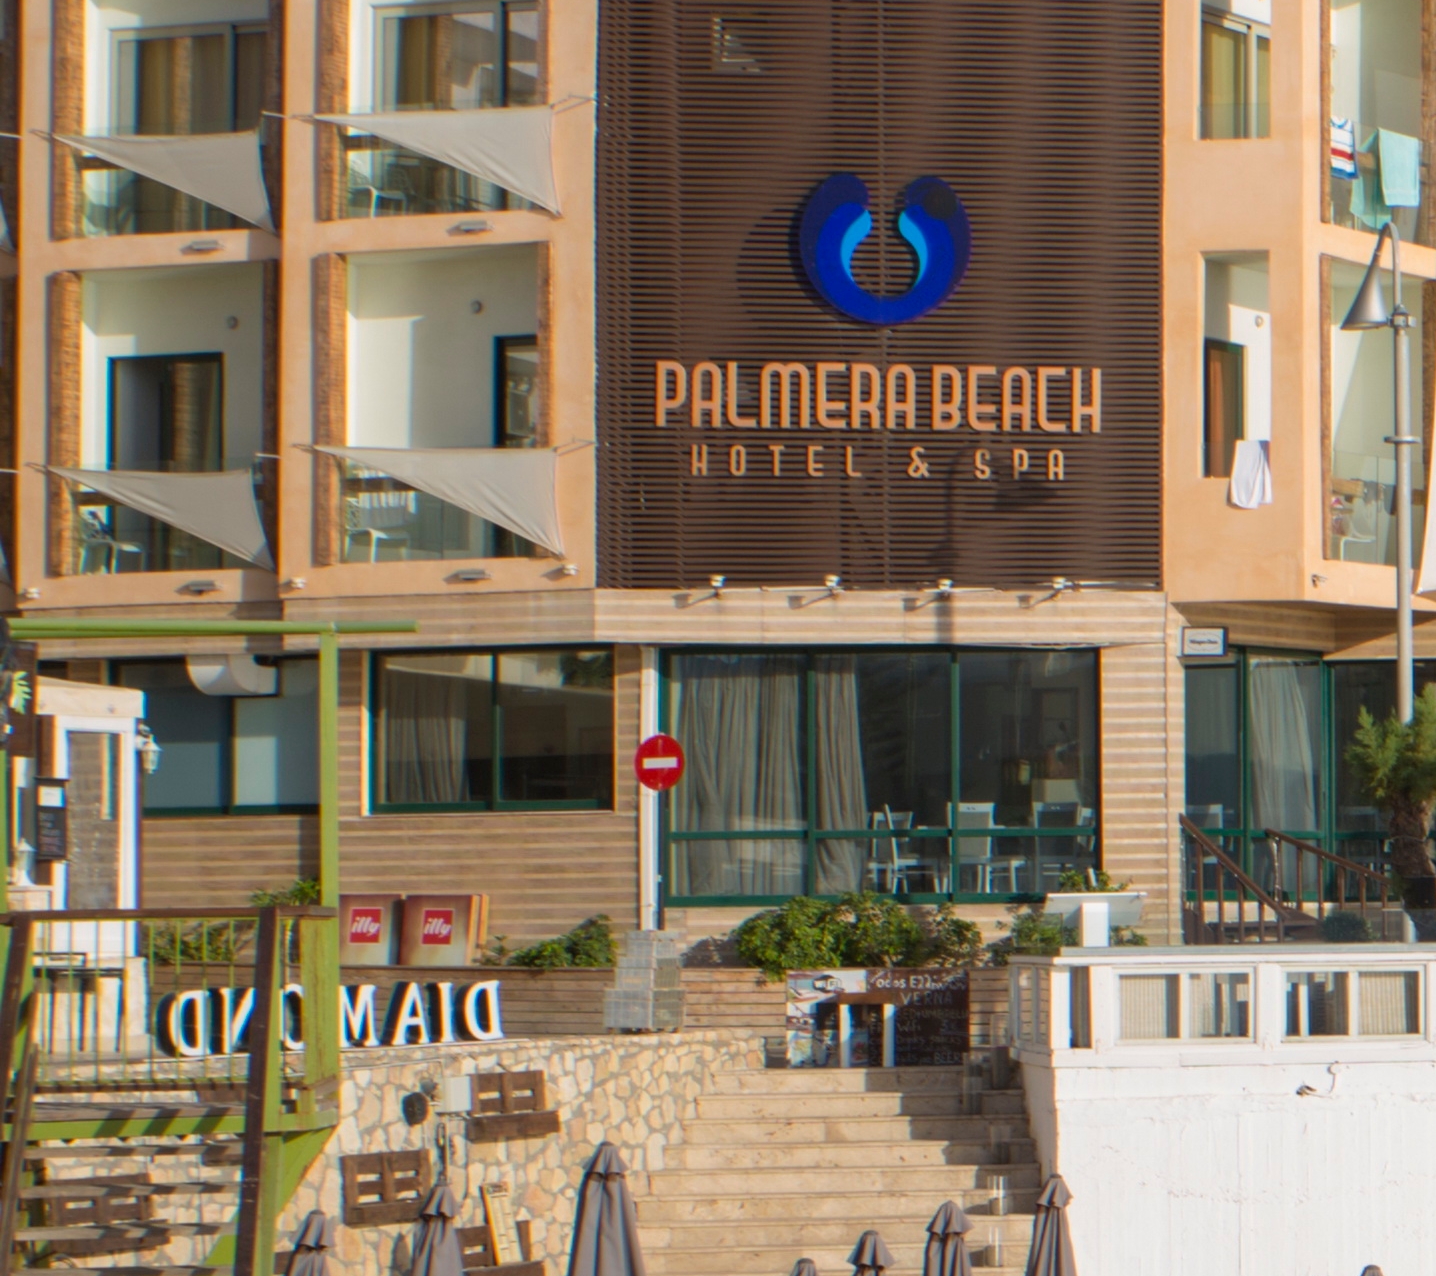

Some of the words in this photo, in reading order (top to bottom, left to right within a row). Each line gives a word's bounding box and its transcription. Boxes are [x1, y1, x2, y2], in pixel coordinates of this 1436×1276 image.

[655, 360, 916, 429] PALMERA
[932, 364, 1101, 434] BEACH
[691, 444, 861, 478] HOTEL
[907, 446, 930, 479] &
[974, 447, 1065, 481] SPA
[351, 916, 381, 936] illy
[424, 918, 452, 938] illy
